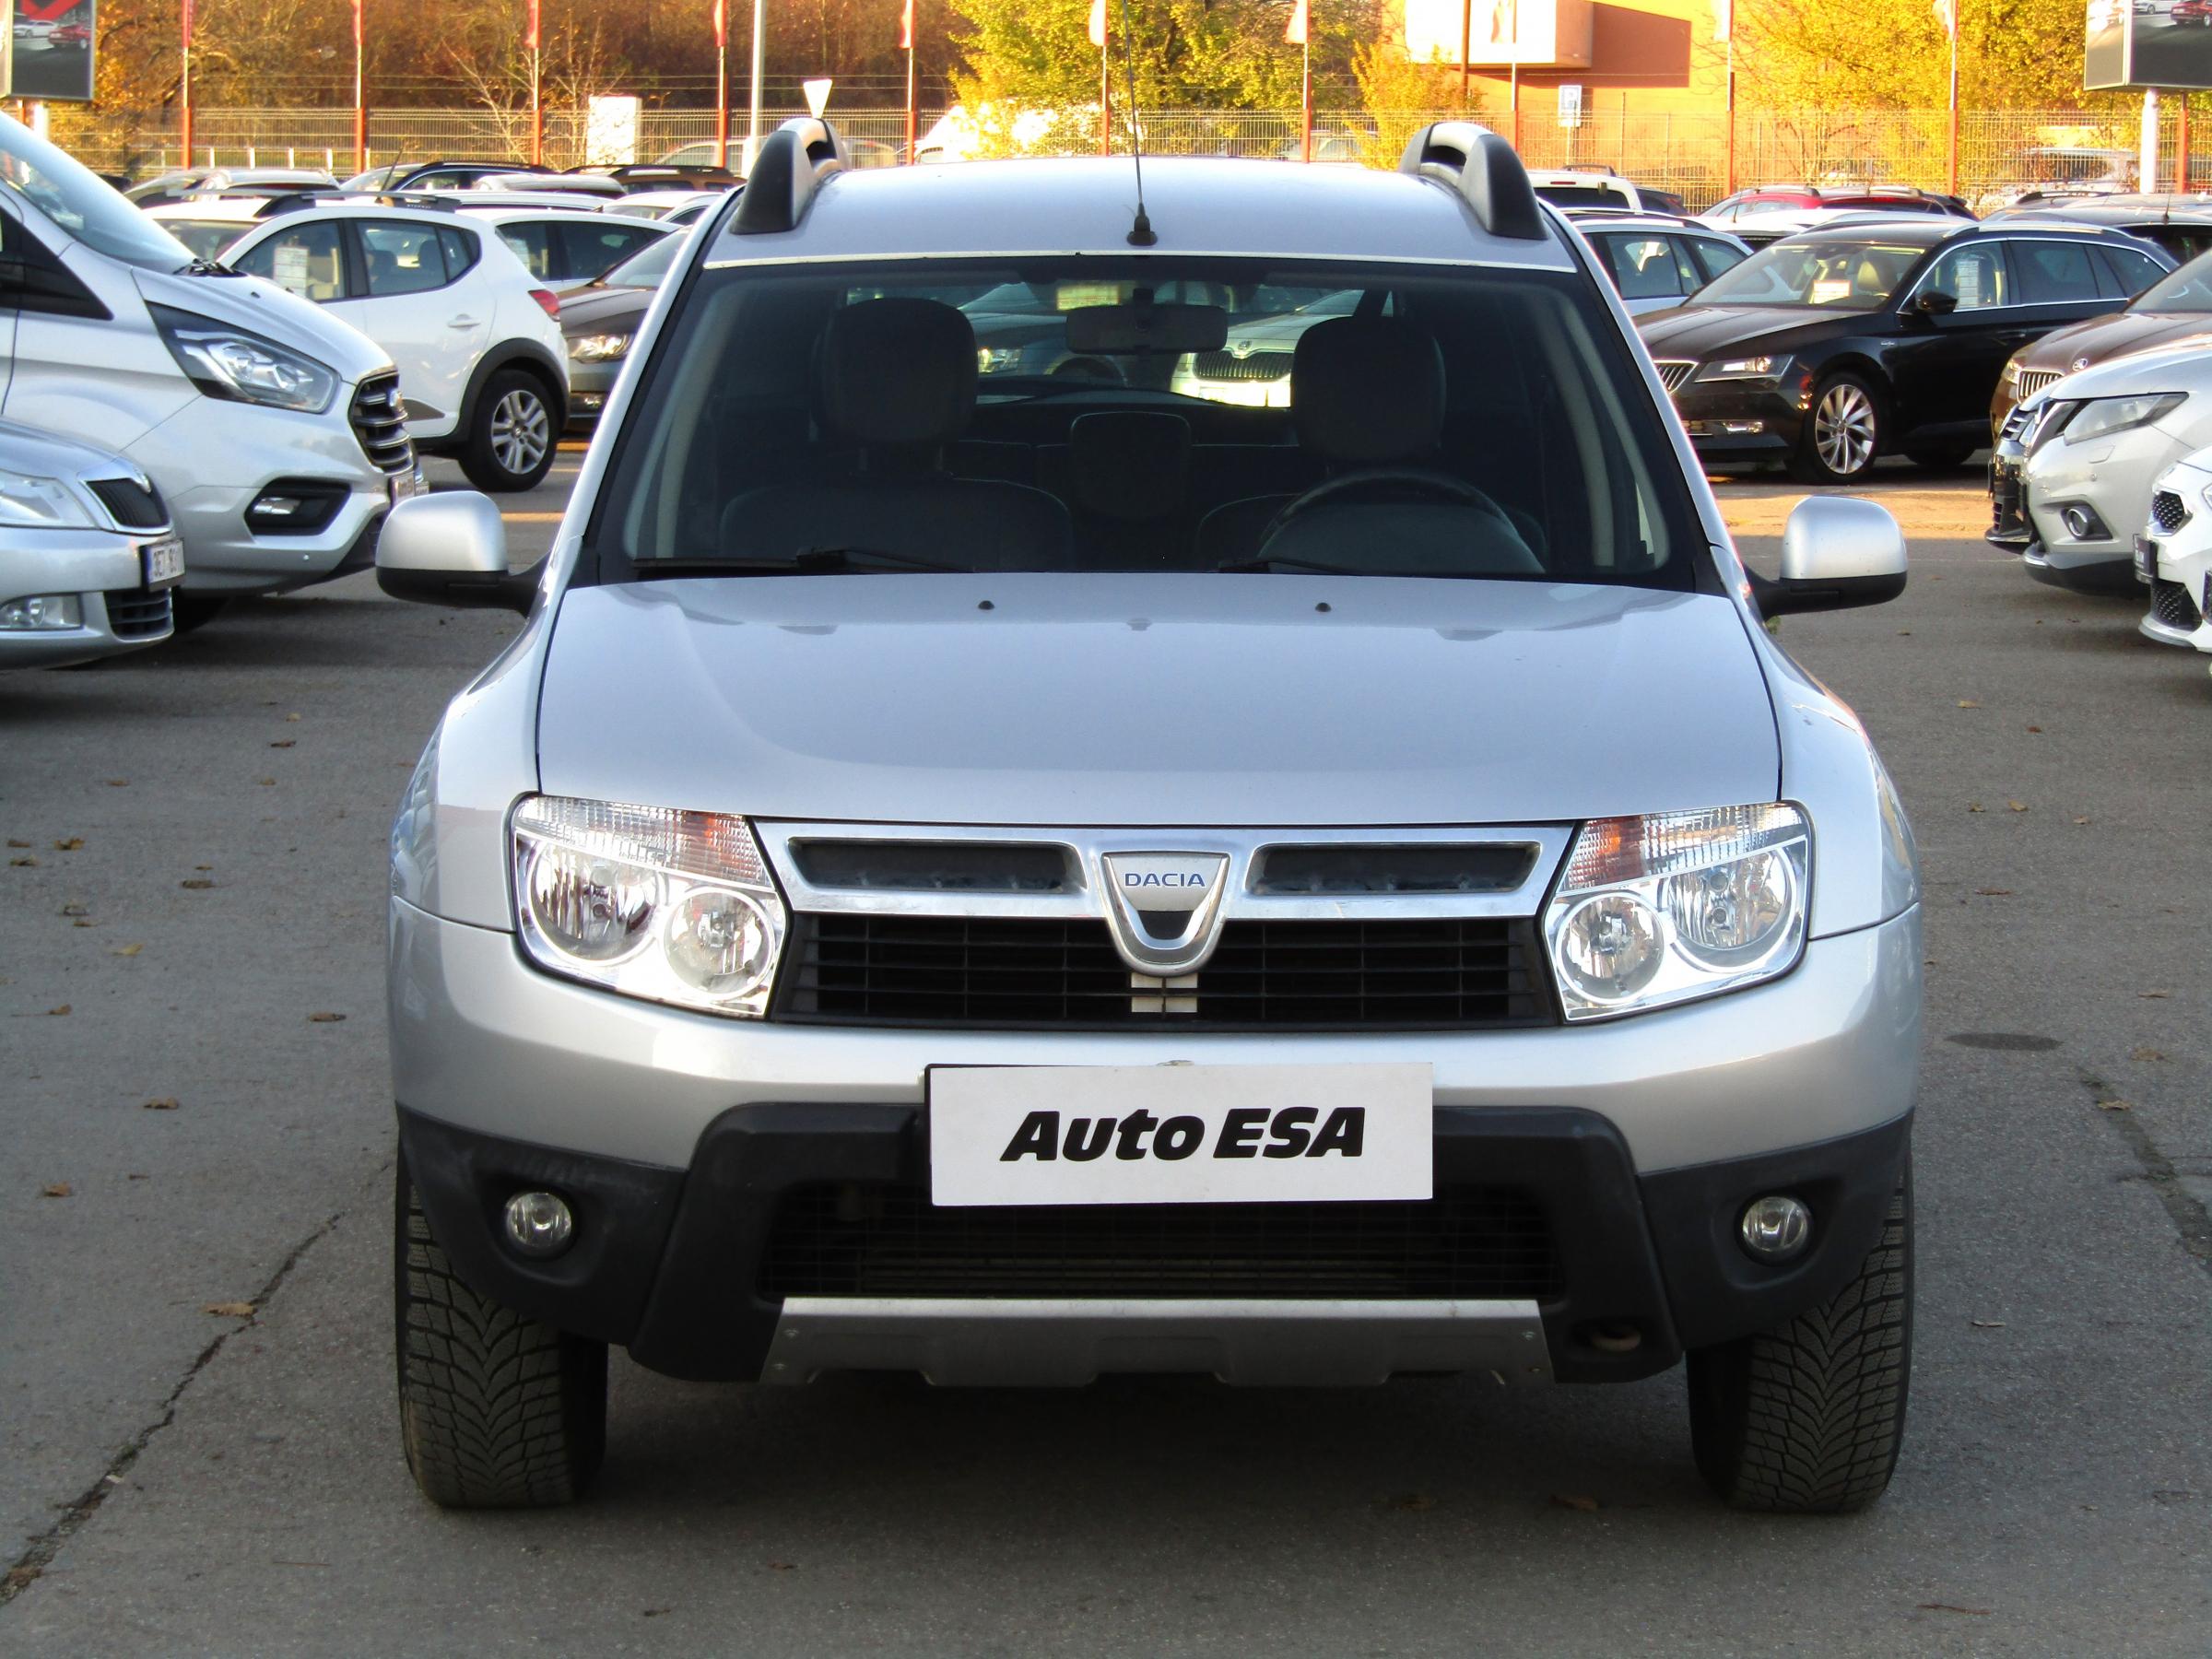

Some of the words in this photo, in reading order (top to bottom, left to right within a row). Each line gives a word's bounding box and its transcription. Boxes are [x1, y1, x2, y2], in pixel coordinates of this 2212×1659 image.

[1124, 873, 1206, 887] DACIA
[999, 1109, 1206, 1161] Auto
[1213, 1106, 1366, 1159] ESA
